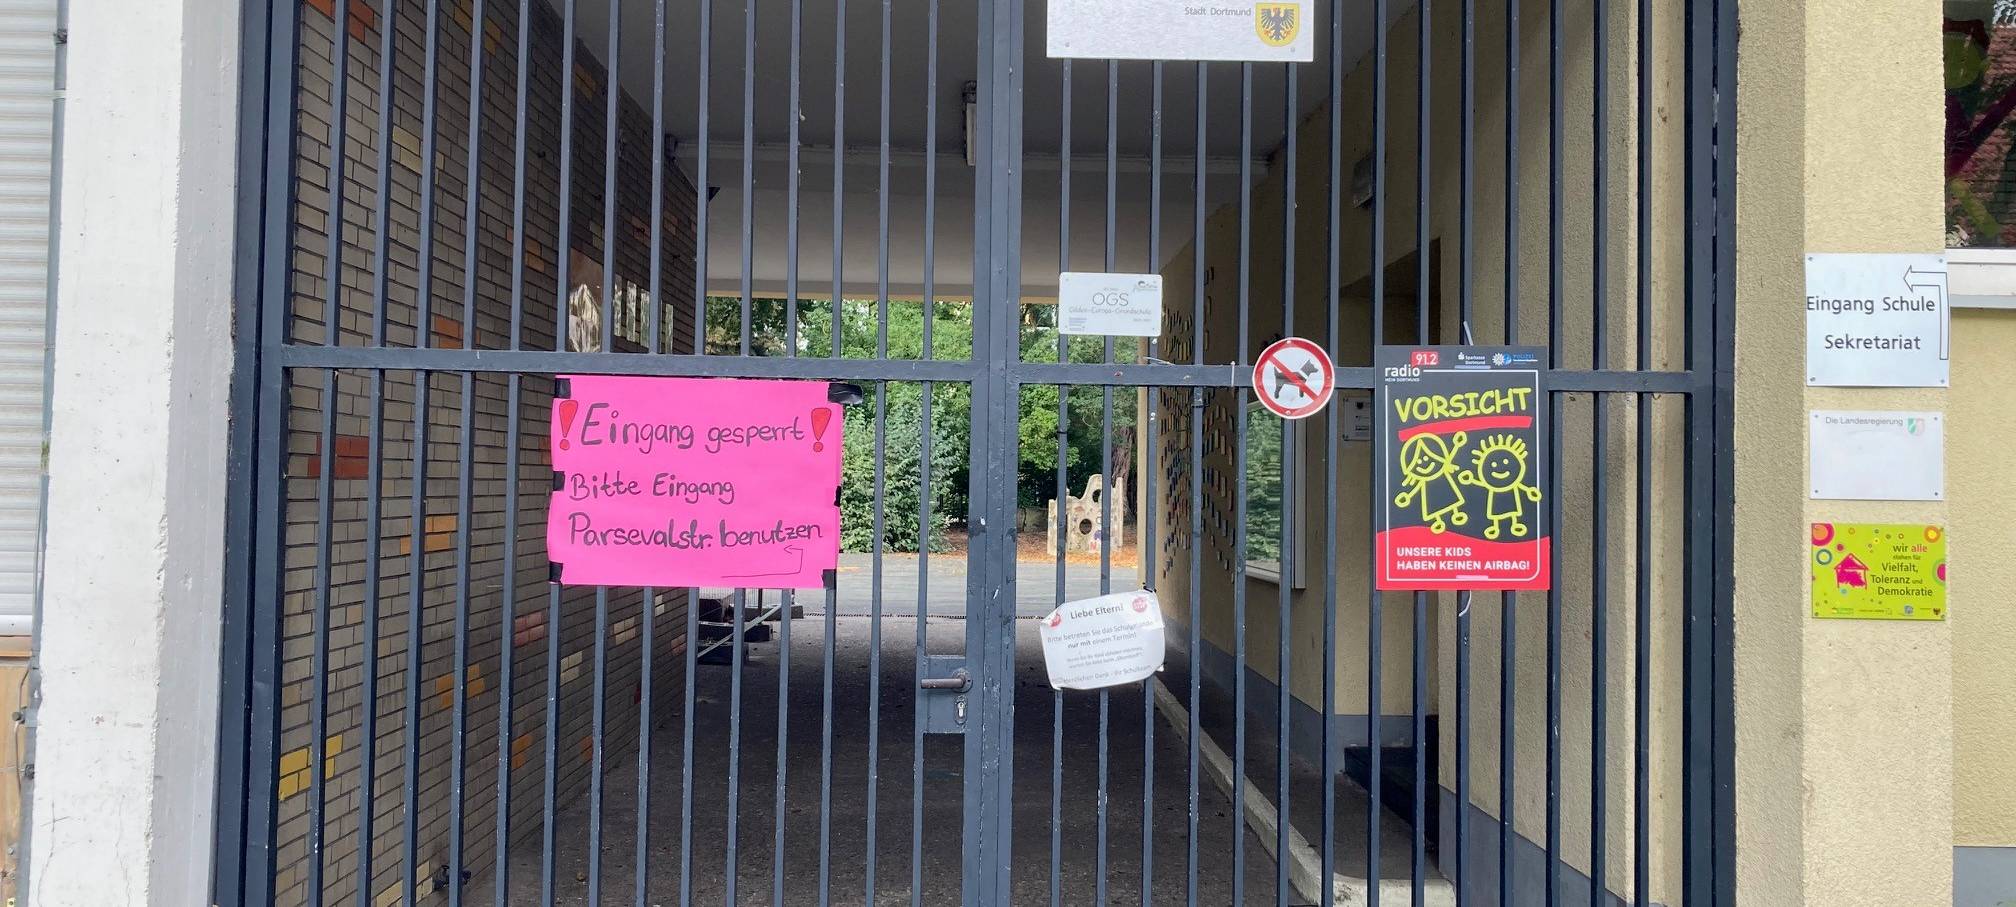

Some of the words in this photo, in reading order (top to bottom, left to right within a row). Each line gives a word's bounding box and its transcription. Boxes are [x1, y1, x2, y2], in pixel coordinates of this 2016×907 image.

[1184, 6, 1207, 16] Stadt
[1210, 7, 1251, 16] Dortmund
[1092, 292, 1129, 306] OGS
[1806, 296, 1875, 315] Eingang
[1882, 296, 1936, 312] Schule
[1824, 333, 1921, 350] Sekretariat
[1415, 353, 1438, 366] 91.2
[1384, 364, 1421, 377] radio
[1394, 388, 1531, 423] VORSICHT
[1825, 416, 1838, 425] Die
[1840, 417, 1904, 426] Landesregierung
[580, 402, 694, 454] Eingang
[704, 416, 805, 454] gesperrt
[569, 471, 642, 501] Bitte
[652, 472, 735, 505] Eingang
[568, 511, 712, 550] Parsevalstr.
[719, 519, 824, 549] benutzen
[1396, 547, 1442, 557] UNSERE
[1444, 547, 1472, 557] KIDS
[1893, 543, 1909, 553] wir
[1911, 543, 1928, 553] alle
[1396, 560, 1436, 571] HABEN
[1439, 560, 1482, 571] KEINEN
[1484, 560, 1530, 571] AIRBAG!
[1881, 562, 1919, 573] Vielfalt,
[1870, 574, 1911, 584] Toleranz
[1877, 586, 1933, 597] Demokratie
[1070, 609, 1094, 620] Liebe
[1095, 603, 1124, 616] Eltern!
[1063, 630, 1091, 641] betreten
[1102, 626, 1114, 634] das
[1080, 639, 1092, 647] mit
[1092, 636, 1113, 646] einem
